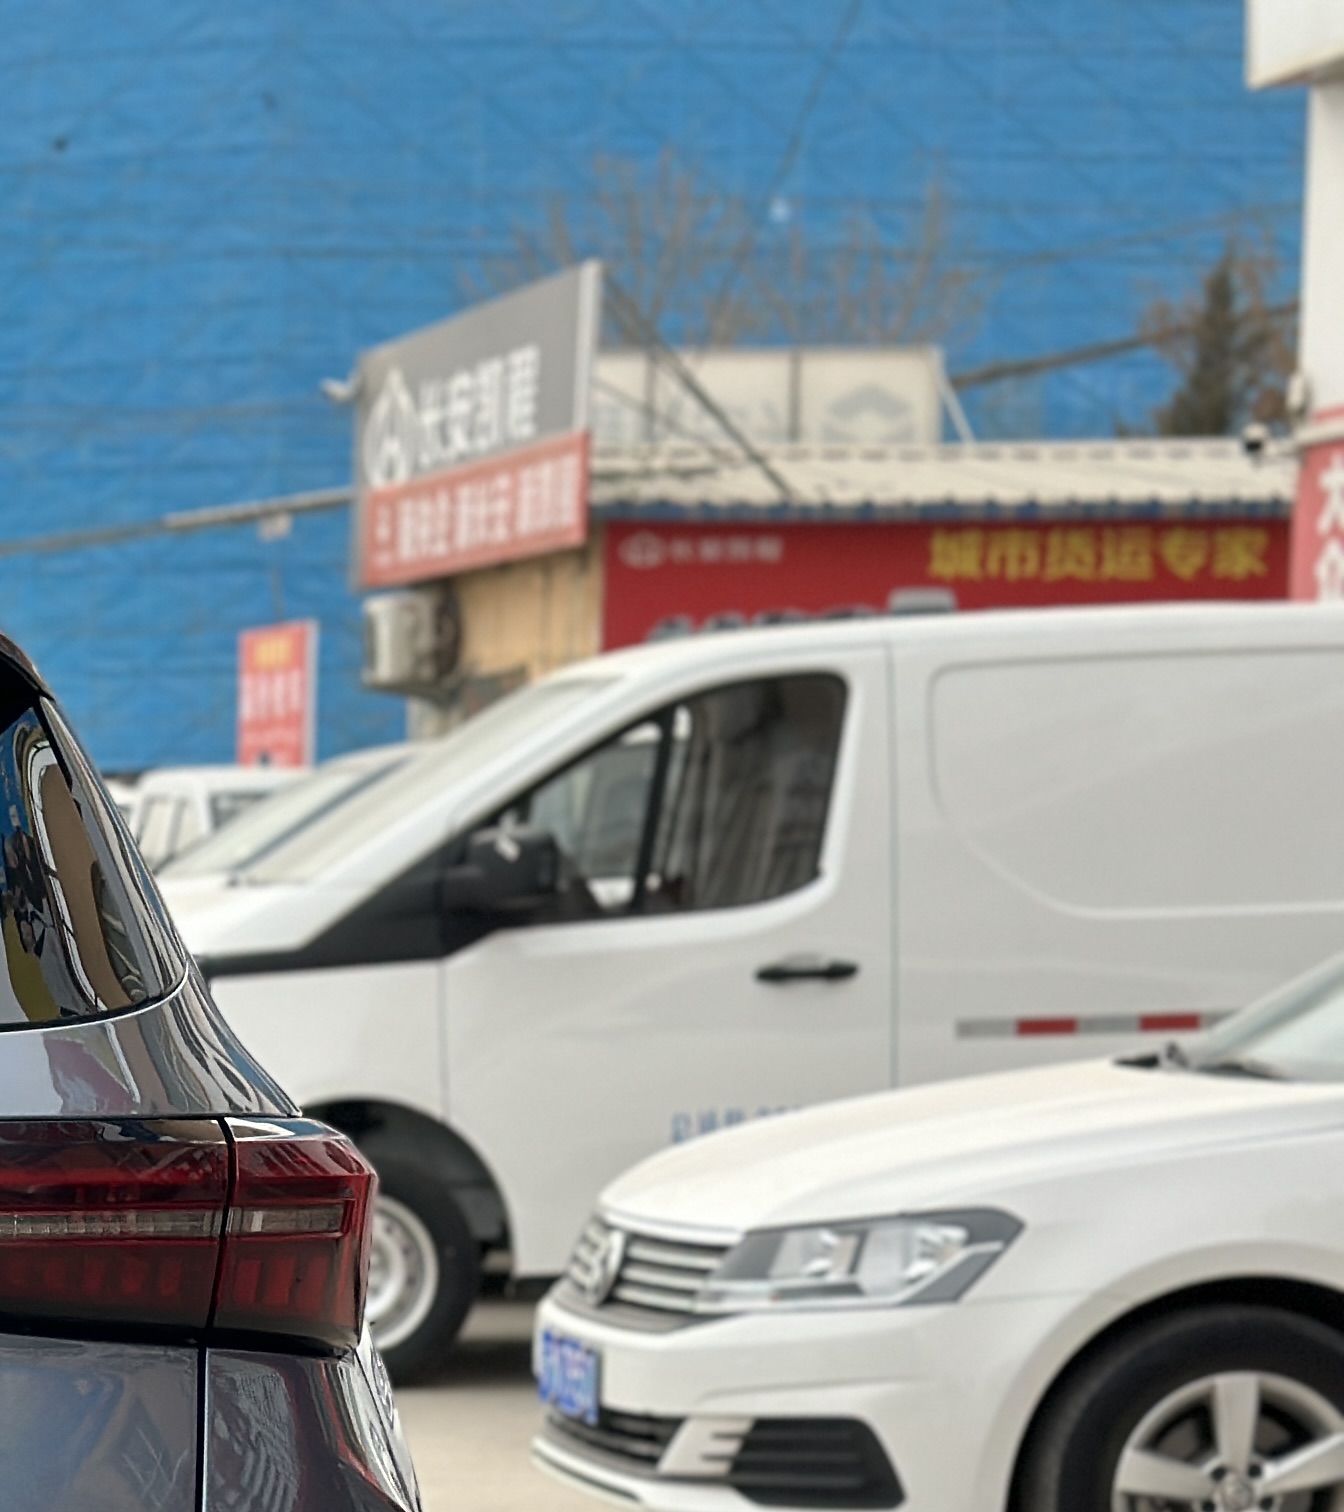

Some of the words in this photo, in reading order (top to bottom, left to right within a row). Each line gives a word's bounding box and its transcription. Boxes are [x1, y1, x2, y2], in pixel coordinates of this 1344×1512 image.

[930, 528, 1268, 582] 城市货运专家
